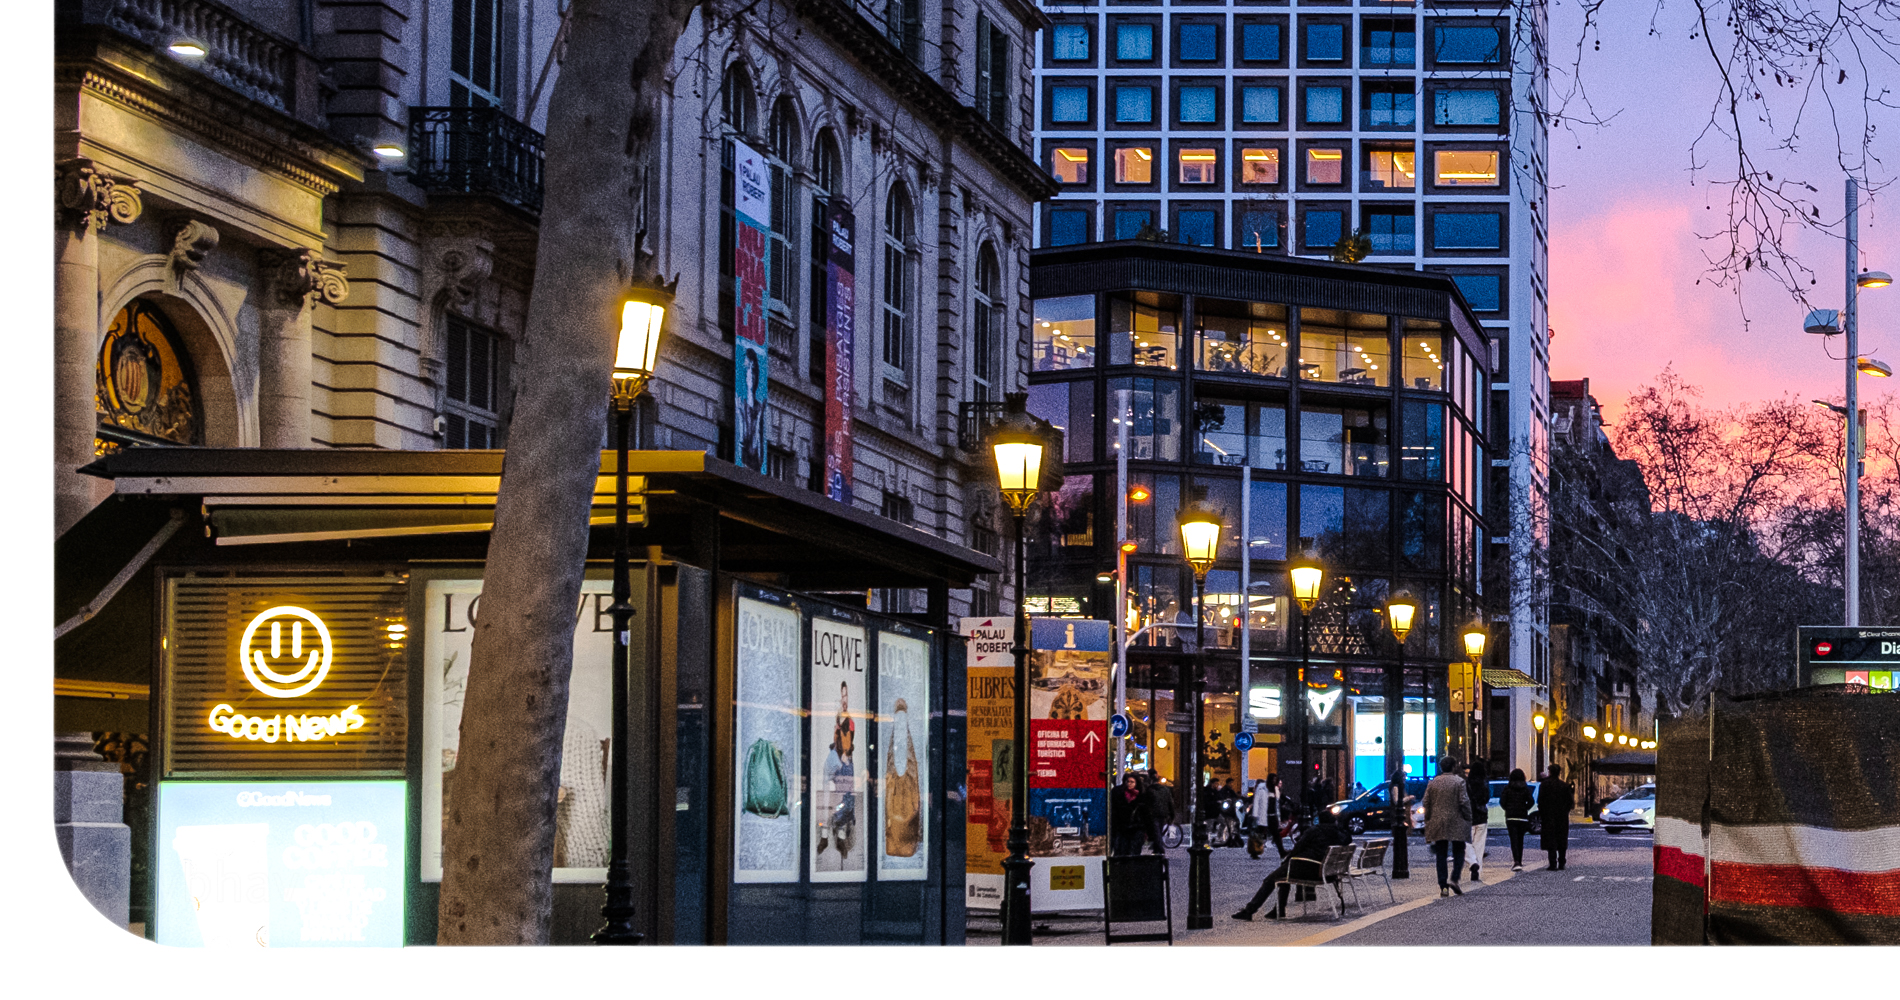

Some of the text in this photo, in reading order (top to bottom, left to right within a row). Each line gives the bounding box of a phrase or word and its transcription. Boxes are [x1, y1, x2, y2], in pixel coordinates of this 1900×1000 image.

[976, 629, 1006, 640] PALAU
[814, 629, 864, 673] LOEWE
[976, 642, 1014, 653] ROBERT
[1871, 675, 1890, 689] L3
[208, 703, 365, 743] Good News
[1037, 730, 1069, 739] OFICINA DE
[1036, 769, 1057, 777] TIENDA
[294, 820, 378, 847] GOOD
